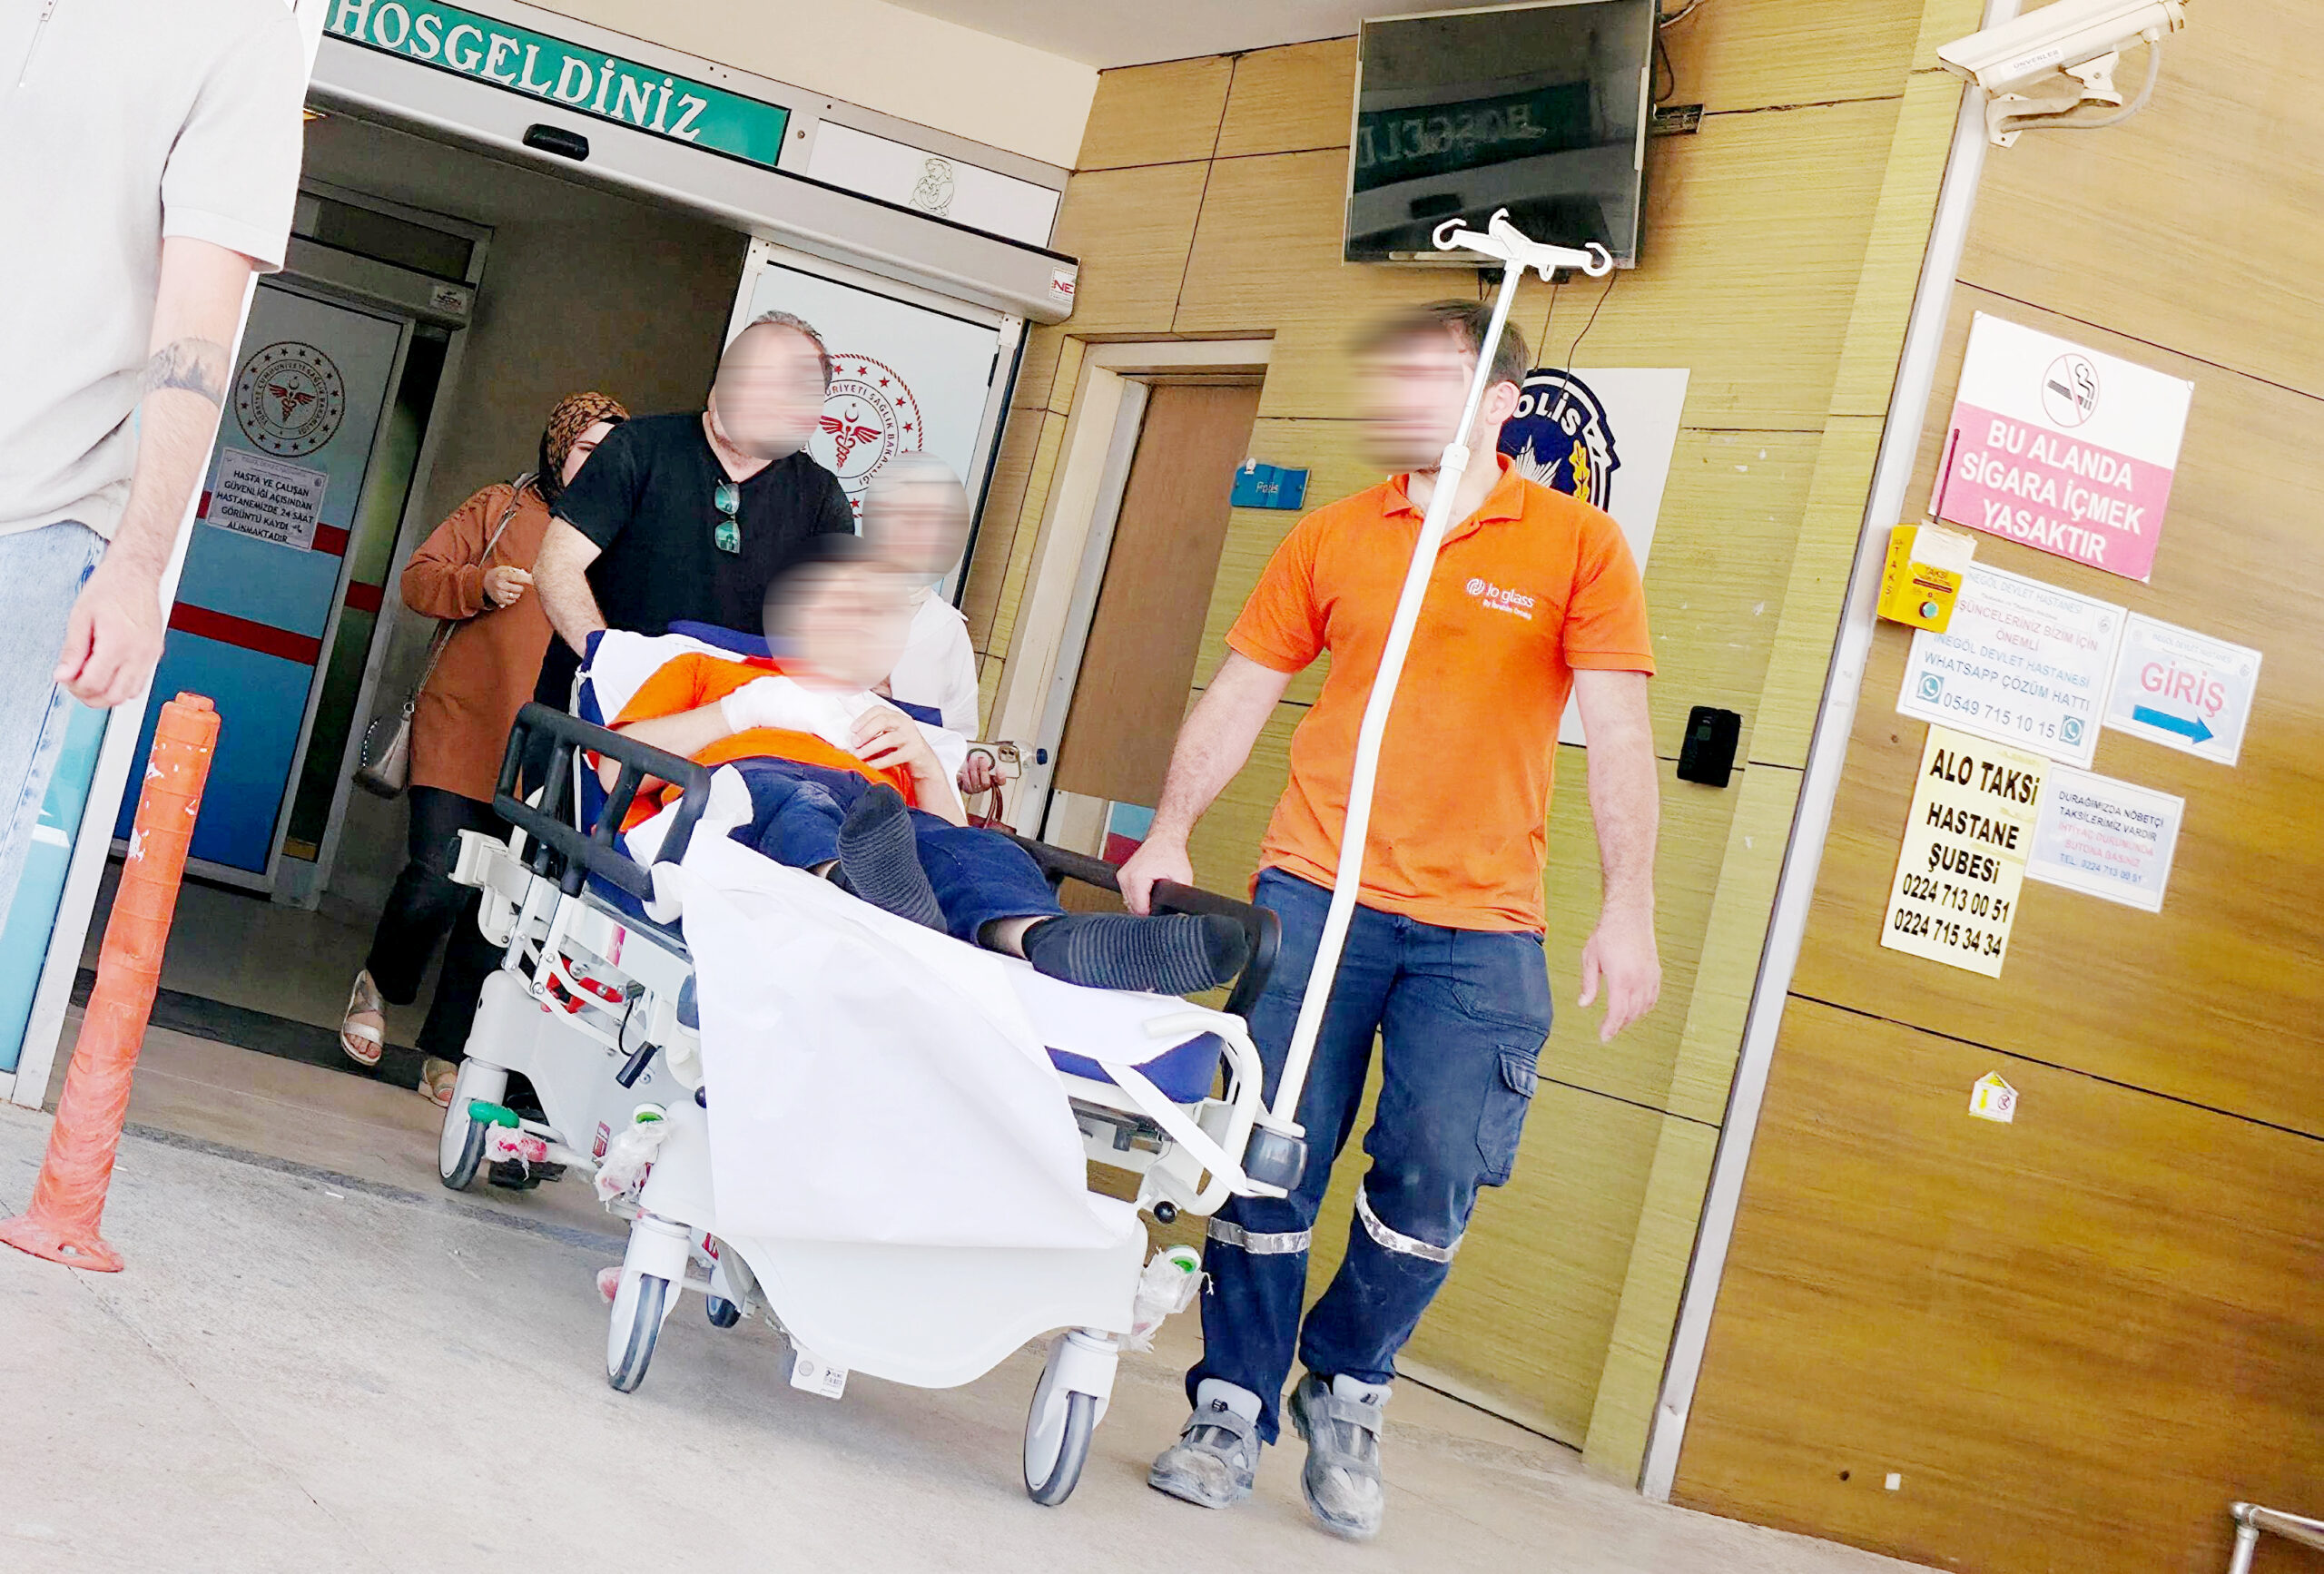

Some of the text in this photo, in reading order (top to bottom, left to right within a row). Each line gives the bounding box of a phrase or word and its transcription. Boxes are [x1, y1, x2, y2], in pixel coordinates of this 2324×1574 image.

[869, 392, 894, 429] SAĞLIK
[1513, 392, 1581, 436] OLİS
[1986, 419, 2132, 491] BU ALANDA
[224, 480, 312, 511] GÜVENLİĞİ AÇISINDAN
[233, 470, 260, 484] HASTA
[262, 477, 273, 487] VE
[275, 482, 310, 497] ÇALIŞAN
[1960, 450, 2145, 536] SİGARA İÇMEK
[222, 506, 289, 530] GÖRÜNTÜ KAYDI
[291, 512, 314, 524] SAAT
[1983, 498, 2106, 564] YASAKTIR
[1996, 629, 2040, 652] ÖNEMLİ
[2075, 634, 2098, 652] İÇİN
[1925, 651, 2090, 712] WHATSAPP ÇÖZÜM HATTI
[1980, 645, 2024, 667] DEVLET
[2026, 660, 2091, 688] HASTANESİ
[2141, 661, 2225, 718] GİRİŞ
[1944, 693, 2055, 739] 0549 715 10 15
[1930, 748, 2041, 806] ALO TAKSİ
[1926, 802, 2020, 850] HASTANE
[1928, 842, 2001, 884] ŞUBESİ
[1903, 873, 2010, 924] 0224 713 00 51
[1894, 908, 2003, 959] 0224 715 34 34
